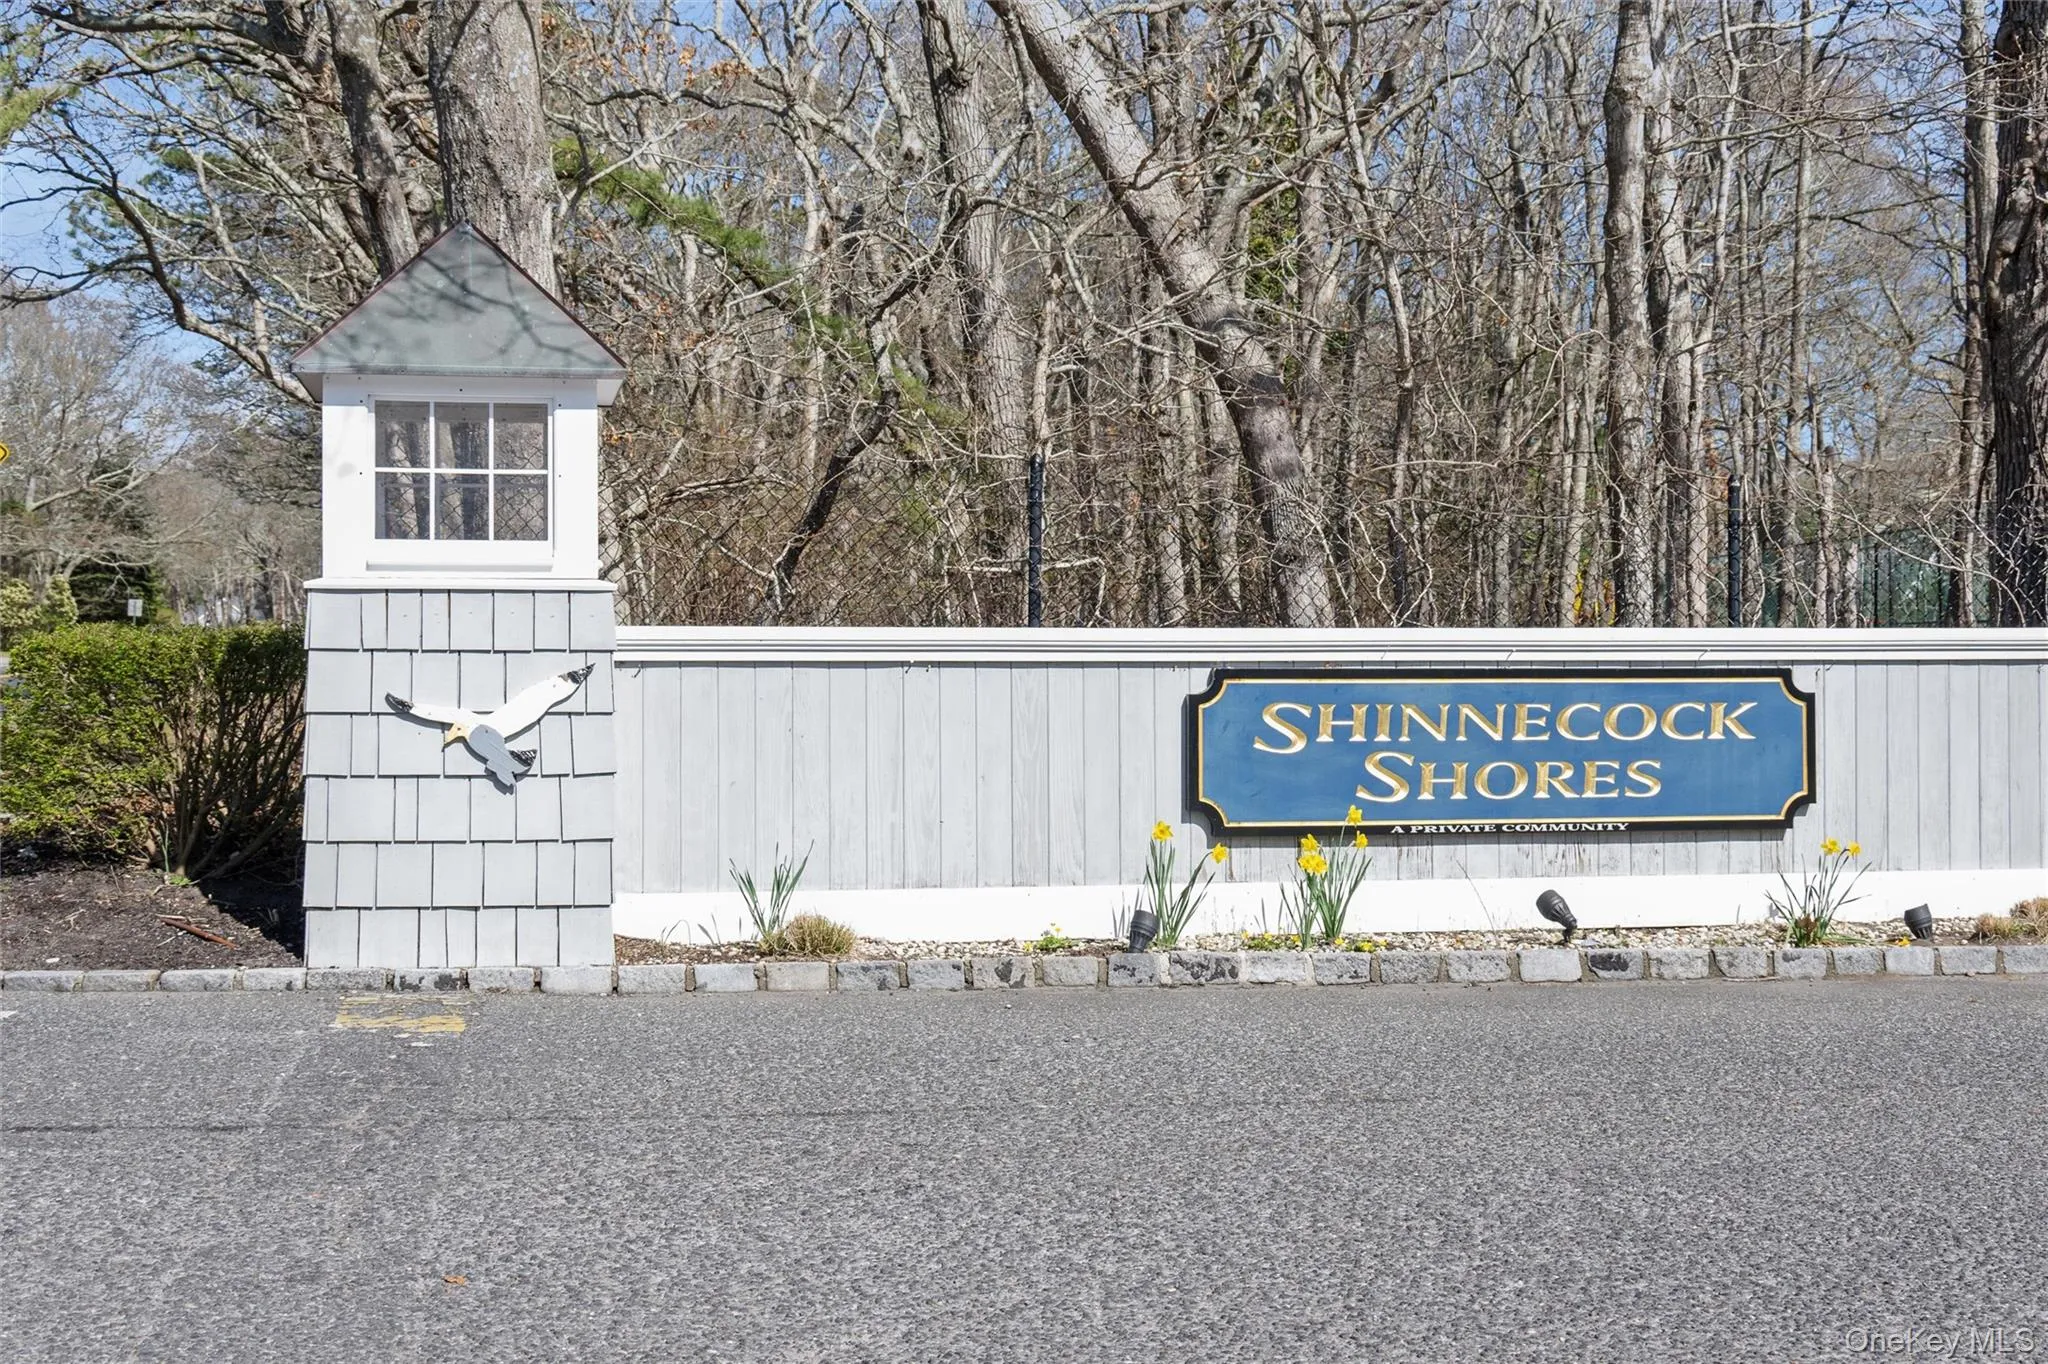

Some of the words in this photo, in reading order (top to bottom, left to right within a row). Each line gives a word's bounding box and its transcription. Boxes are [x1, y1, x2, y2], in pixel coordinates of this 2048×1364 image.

[1253, 702, 1758, 754] SHINNECOCK
[1356, 752, 1662, 803] SHORES
[1391, 825, 1405, 833] A
[1410, 824, 1497, 833] PRIVATE
[1502, 823, 1629, 832] COMMUNITY
